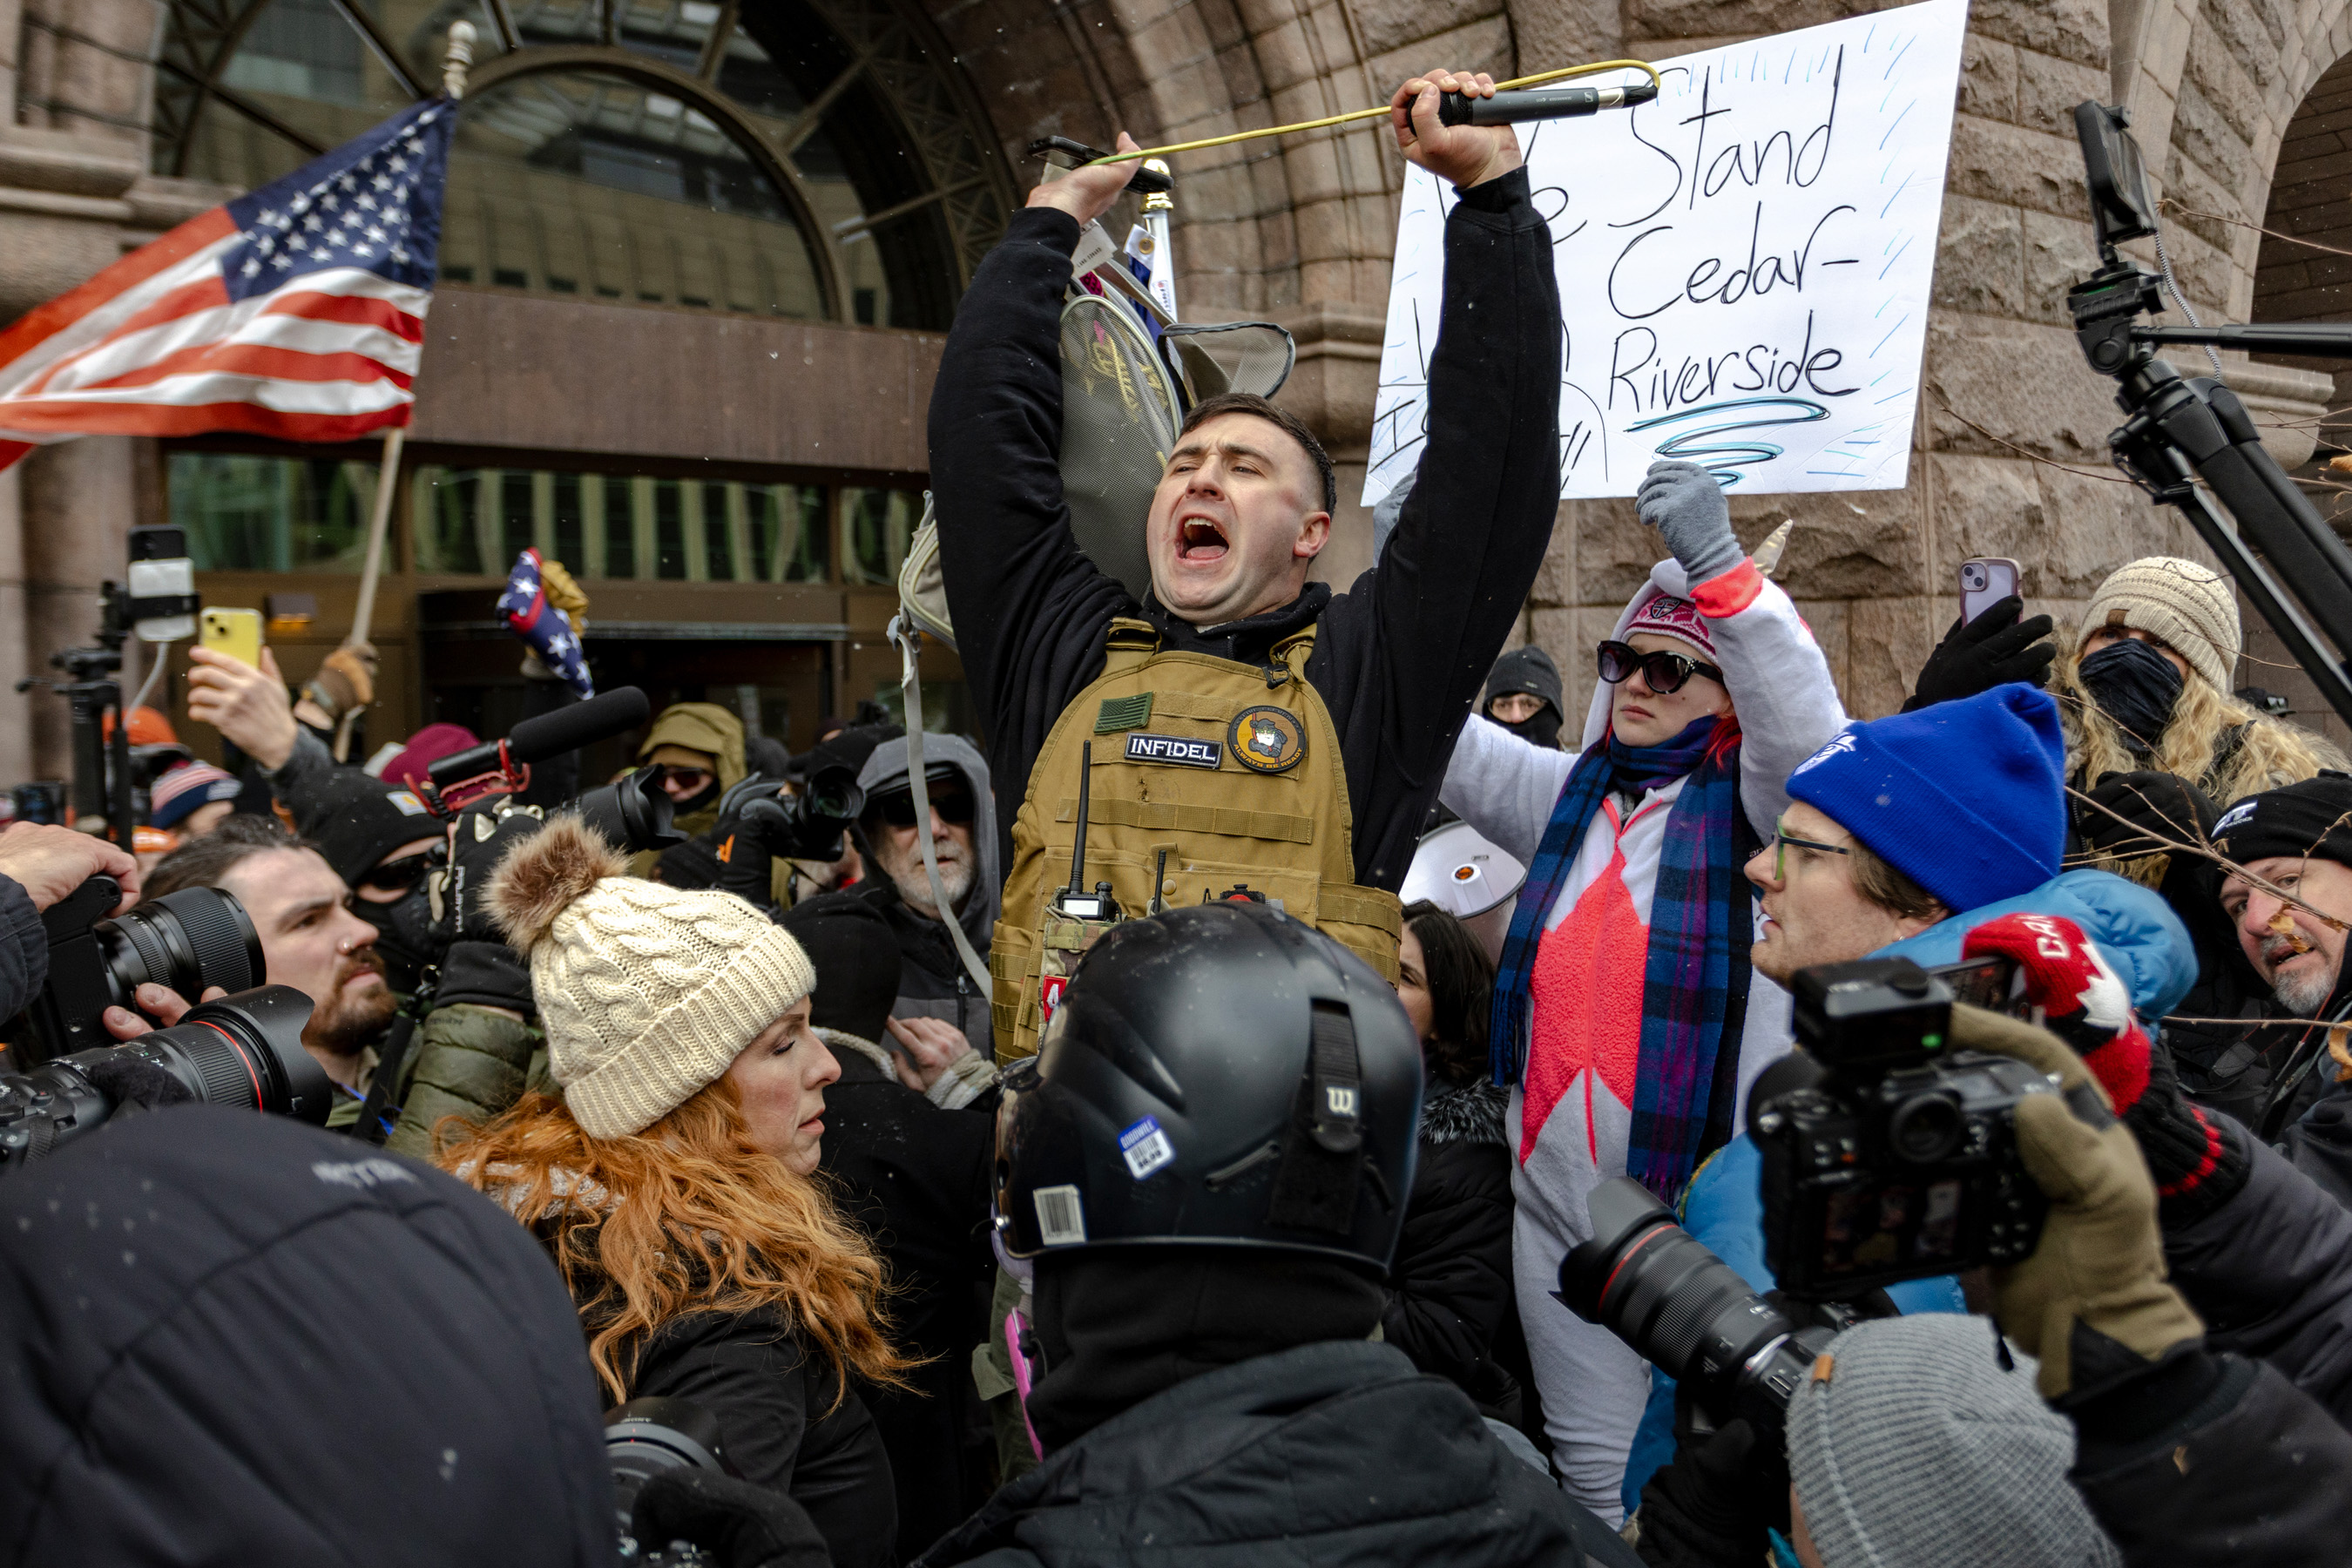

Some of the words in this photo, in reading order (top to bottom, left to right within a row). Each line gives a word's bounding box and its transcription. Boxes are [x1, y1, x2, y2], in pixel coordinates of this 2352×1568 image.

[1607, 44, 1844, 227] Stand
[1608, 201, 1860, 320] Cedar-
[1609, 309, 1861, 412] Riverside
[1132, 737, 1217, 762] INFIDEL
[1233, 744, 1264, 768] ALWAYS
[1281, 747, 1303, 767] READY
[1119, 1119, 1155, 1149] GOODWILL
